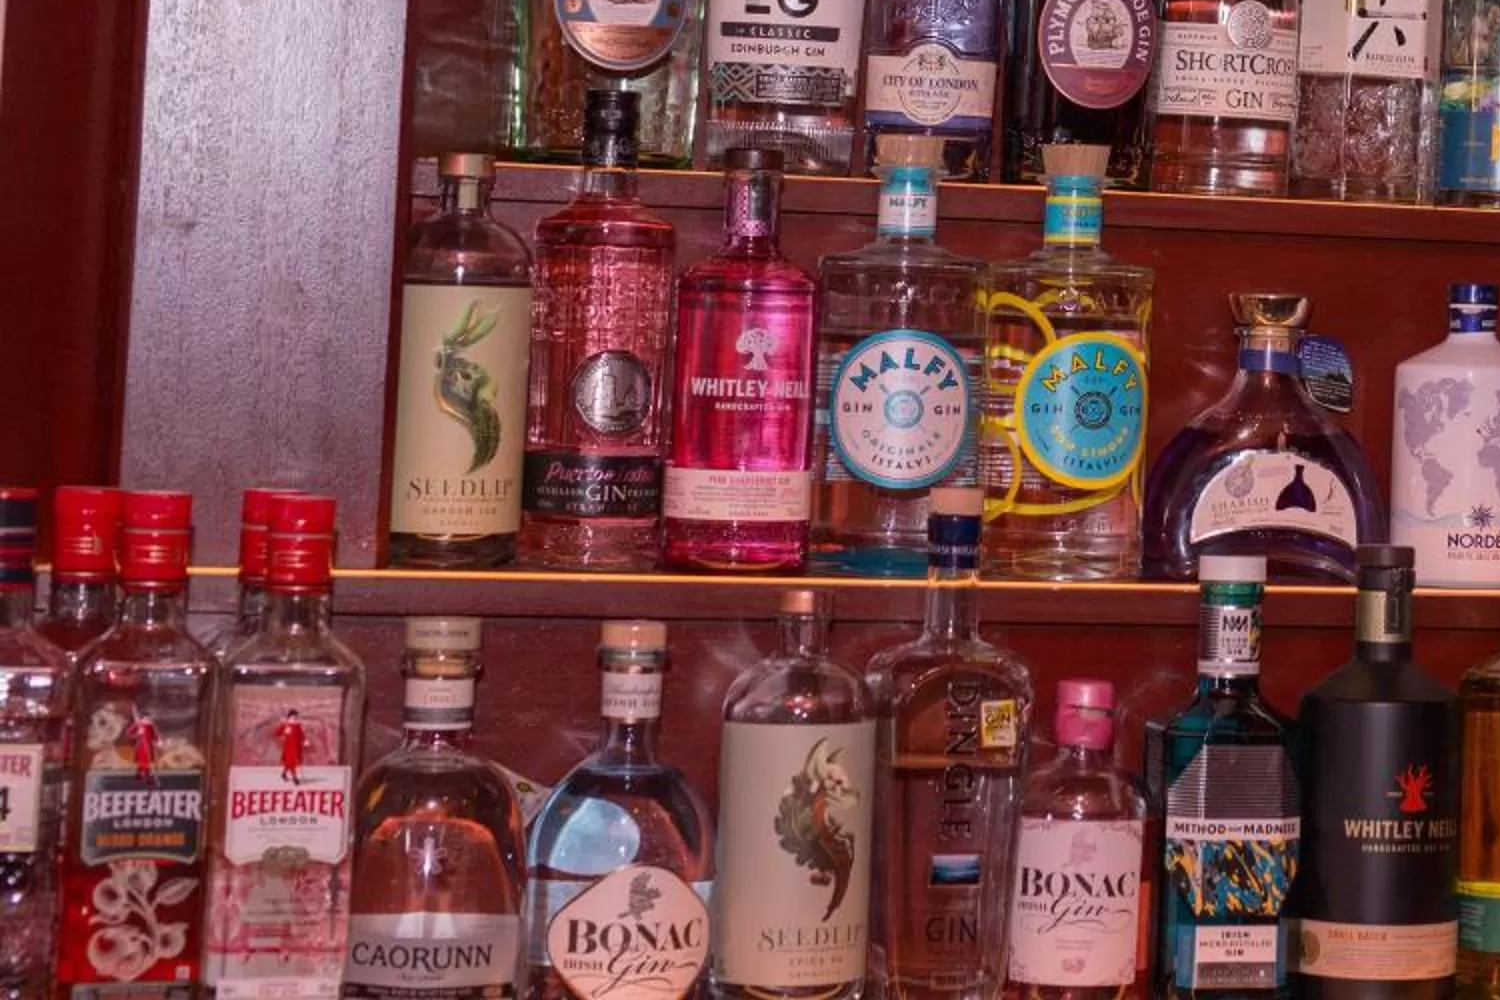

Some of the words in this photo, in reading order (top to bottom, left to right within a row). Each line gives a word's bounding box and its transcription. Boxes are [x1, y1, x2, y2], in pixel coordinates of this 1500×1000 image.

[749, 26, 812, 40] CLASSIC
[730, 43, 799, 56] EDINBURGH
[805, 45, 825, 57] GIN
[1136, 25, 1156, 64] GIN
[908, 76, 925, 89] OF
[929, 77, 979, 91] LONDON
[1225, 89, 1263, 110] GIN
[848, 347, 961, 394] MALFY
[1040, 348, 1139, 394] MALFY
[692, 377, 769, 397] WHITLEY
[842, 402, 874, 414] GIN
[933, 404, 962, 418] GIN
[1030, 402, 1064, 416] GIN
[585, 484, 627, 502] GIN
[942, 678, 982, 842] DINGLE
[83, 790, 204, 823] BEEFEATER
[231, 790, 346, 821] BEEFEATER
[113, 816, 174, 830] LONDON
[259, 816, 319, 827] LONDON
[1173, 822, 1227, 837] METHOD
[1344, 818, 1424, 840] WHITLEY
[1019, 866, 1136, 901] BONAC
[567, 918, 703, 956] BONAC
[925, 916, 978, 945] GIN
[351, 942, 493, 974] CAORUNN
